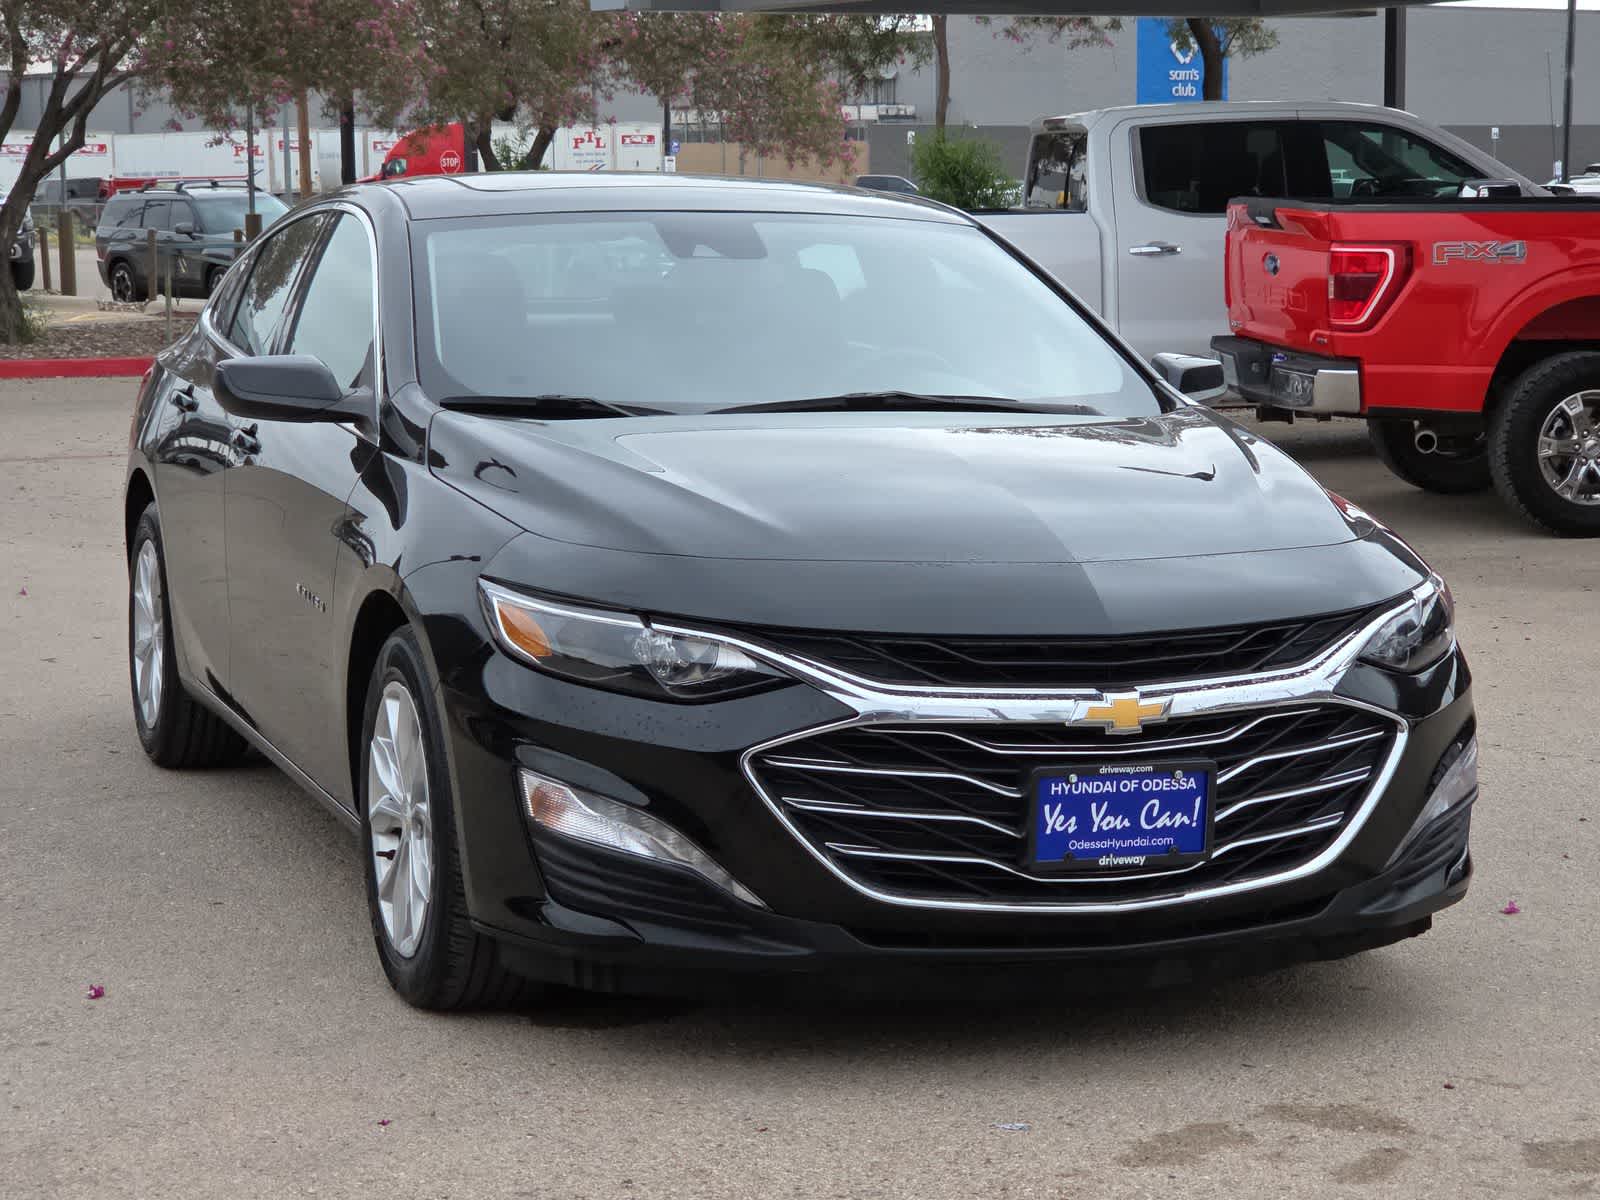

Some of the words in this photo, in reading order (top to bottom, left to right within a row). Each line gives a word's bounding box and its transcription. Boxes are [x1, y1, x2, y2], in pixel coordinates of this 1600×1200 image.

[1169, 69, 1200, 80] sam's
[1172, 83, 1196, 96] club
[572, 131, 606, 149] PTL
[441, 158, 460, 167] STOP
[1432, 240, 1527, 265] FX4
[1099, 765, 1153, 775] driveway.com
[1051, 780, 1117, 795] HYUNDAI
[1119, 780, 1140, 792] OF
[1141, 777, 1197, 791] ODESSA
[1044, 803, 1078, 834] Yes
[1091, 801, 1131, 832] You
[1140, 796, 1201, 830] Can!
[1069, 835, 1174, 851] OdessaHyundai.com
[1099, 854, 1146, 867] driveway
